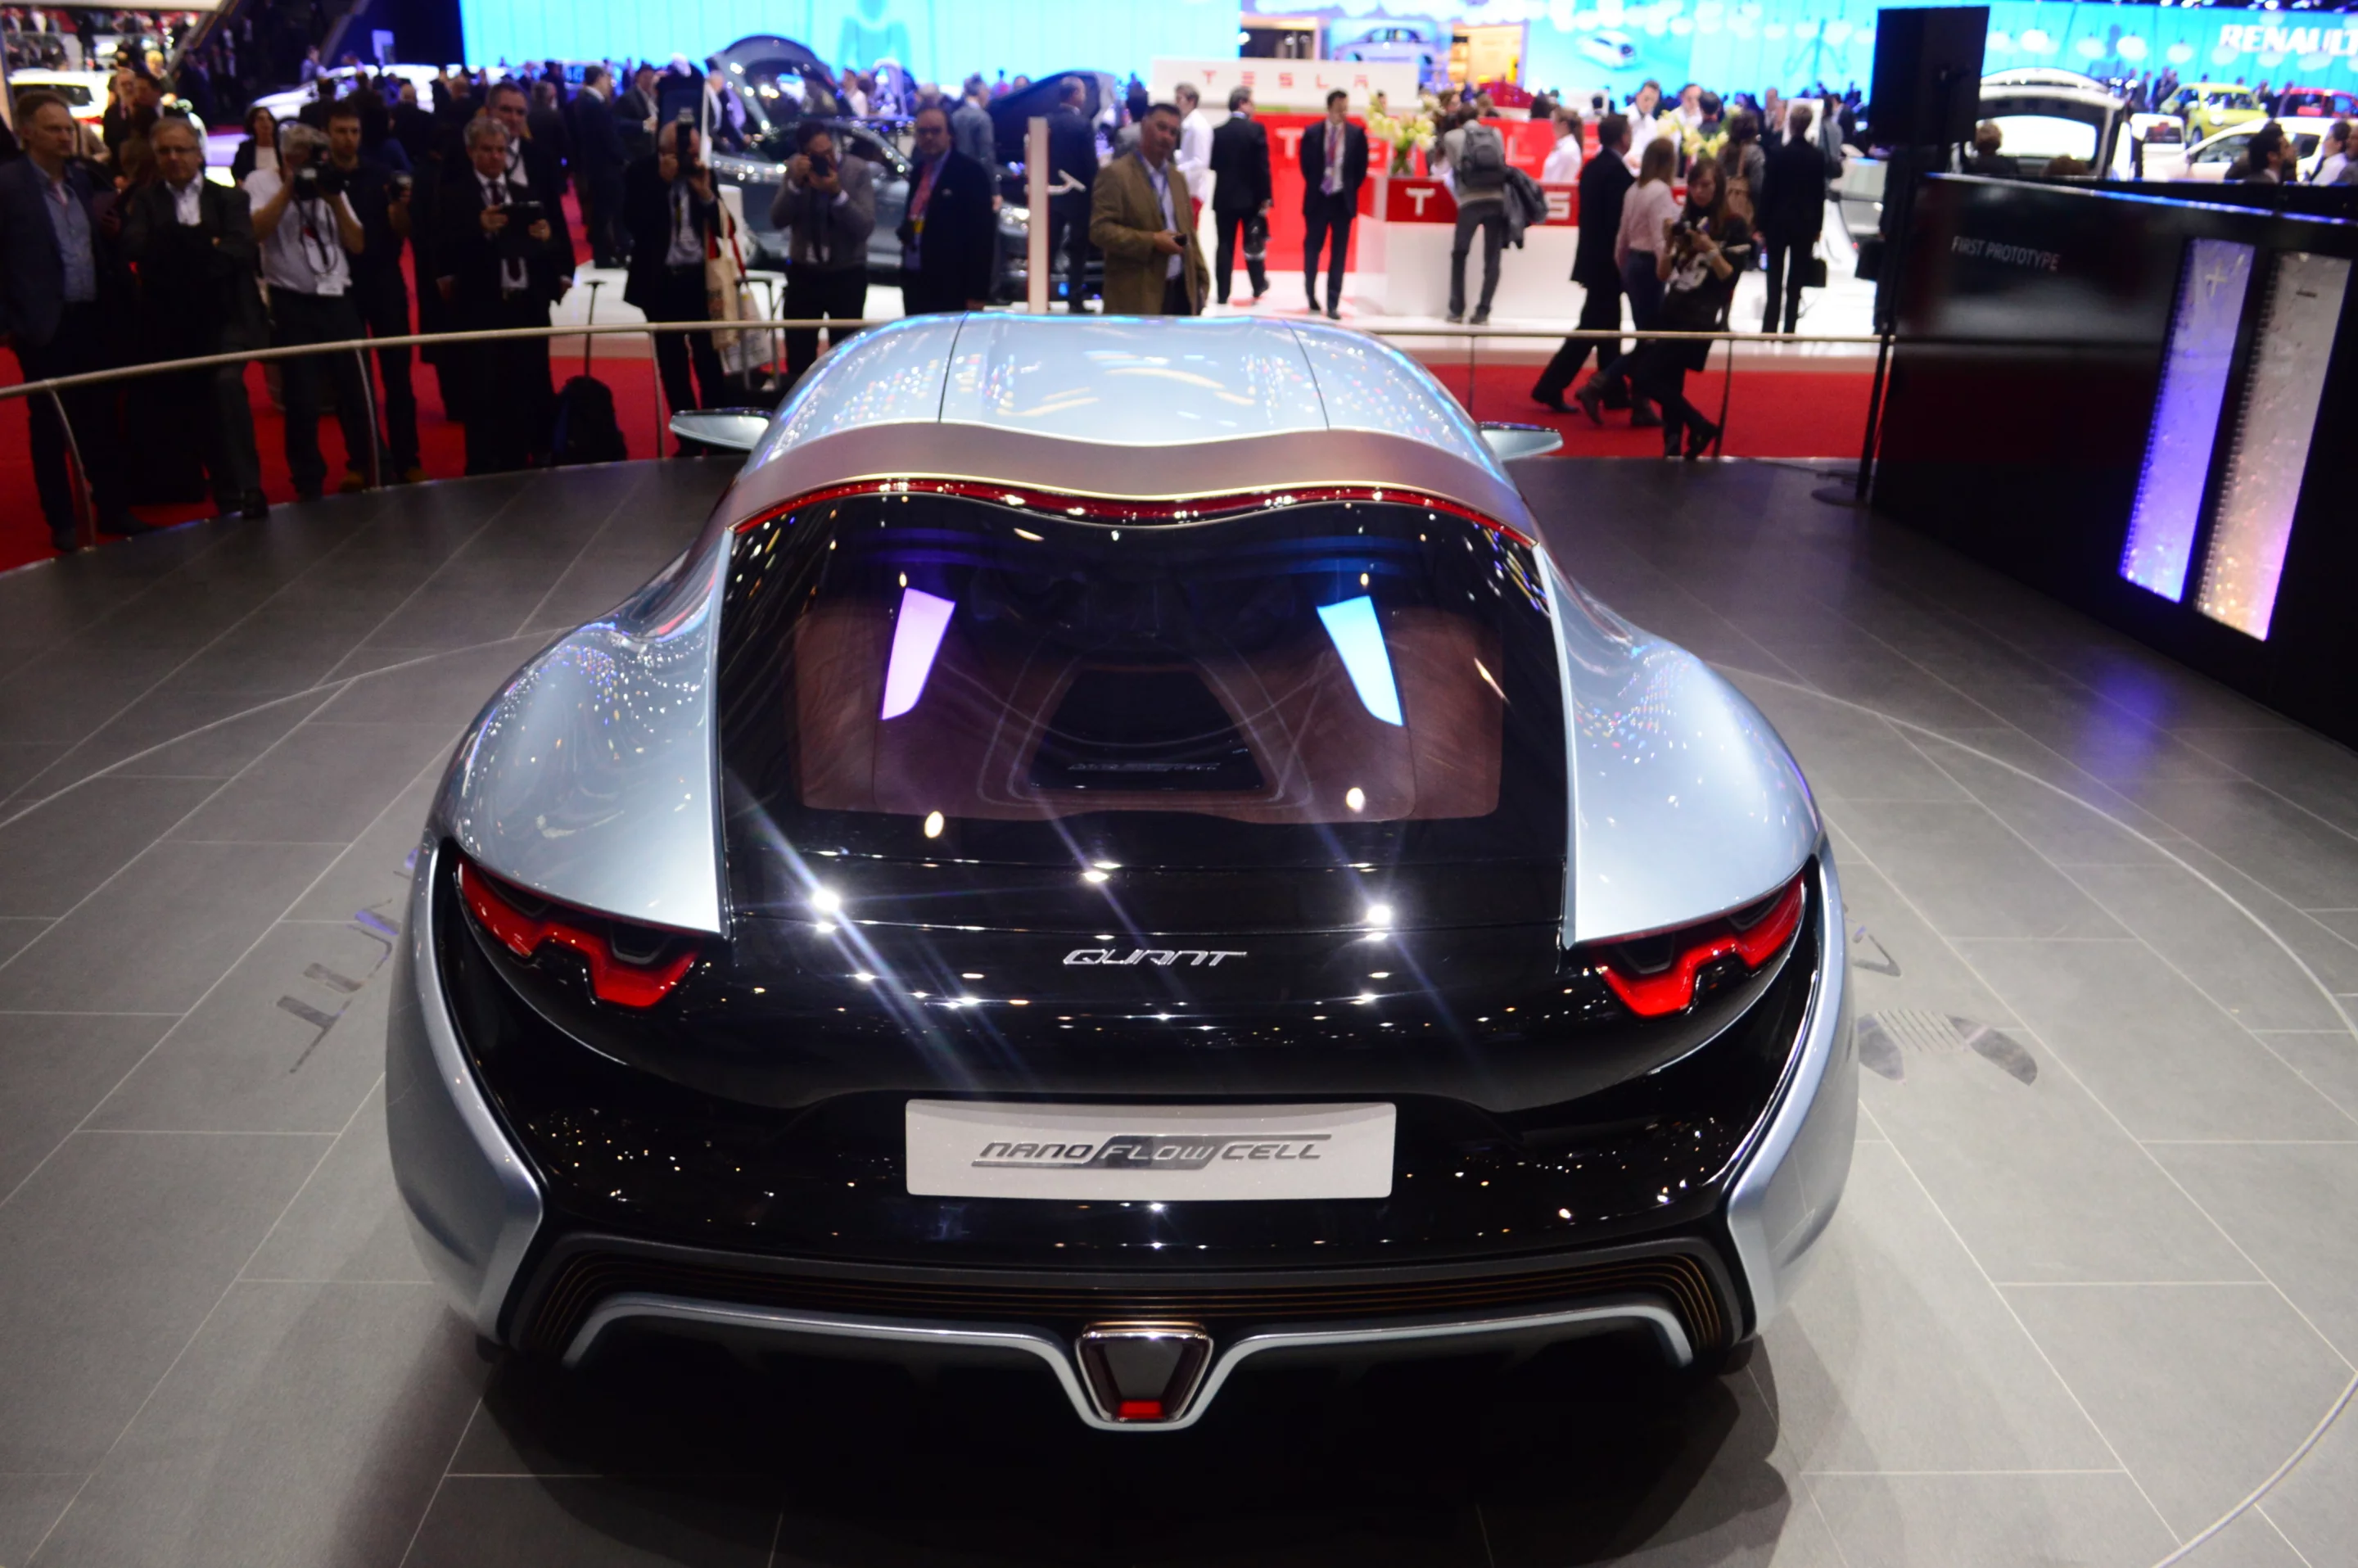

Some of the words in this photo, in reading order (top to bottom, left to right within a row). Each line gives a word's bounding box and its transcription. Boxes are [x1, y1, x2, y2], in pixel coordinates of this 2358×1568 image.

[1202, 70, 1368, 88] TESLA
[1951, 235, 1985, 255] FIRST
[1985, 242, 2060, 271] PROTOTYPE
[1064, 948, 1247, 966] QUANT
